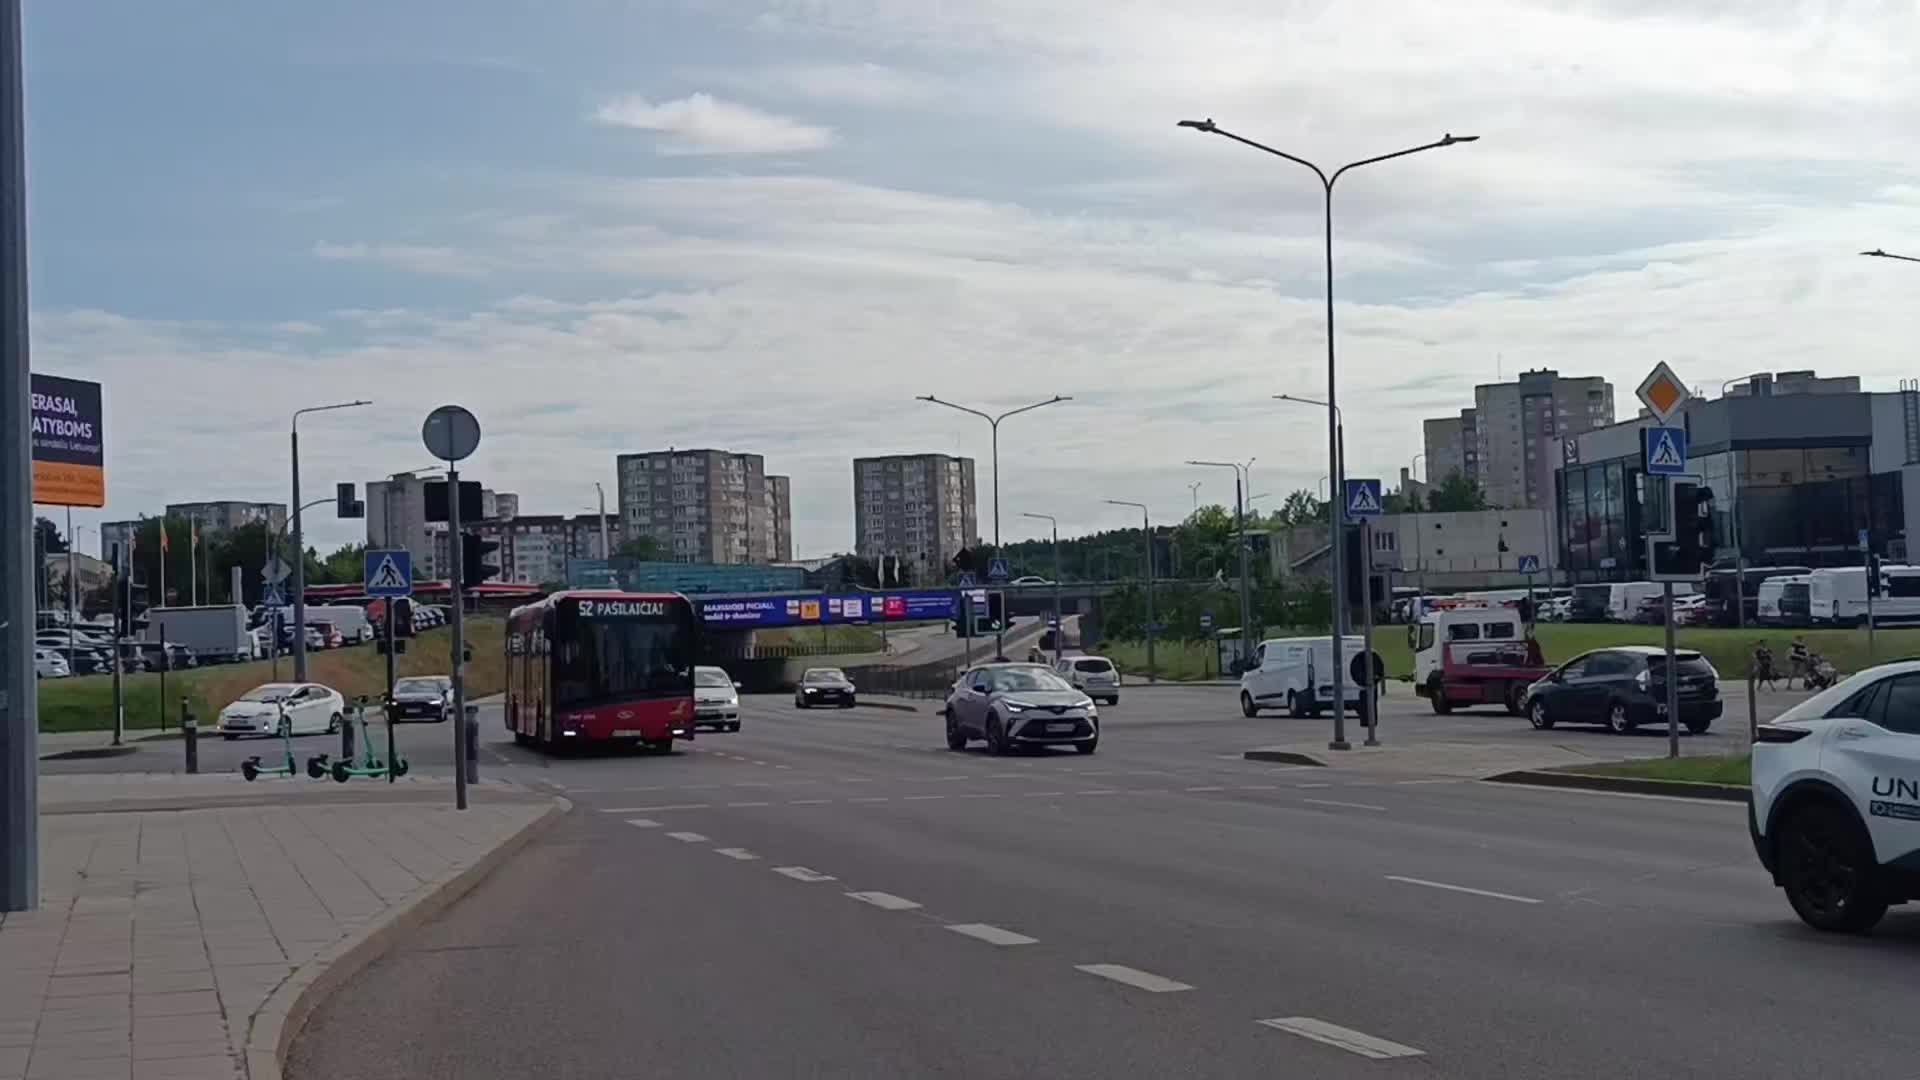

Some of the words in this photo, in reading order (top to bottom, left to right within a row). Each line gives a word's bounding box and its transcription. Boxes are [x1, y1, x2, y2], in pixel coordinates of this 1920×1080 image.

[32, 416, 92, 439] ATYBOMS
[578, 600, 594, 617] 52
[597, 601, 664, 616] PAŠILAIČIAI
[1872, 776, 1918, 801] UN
